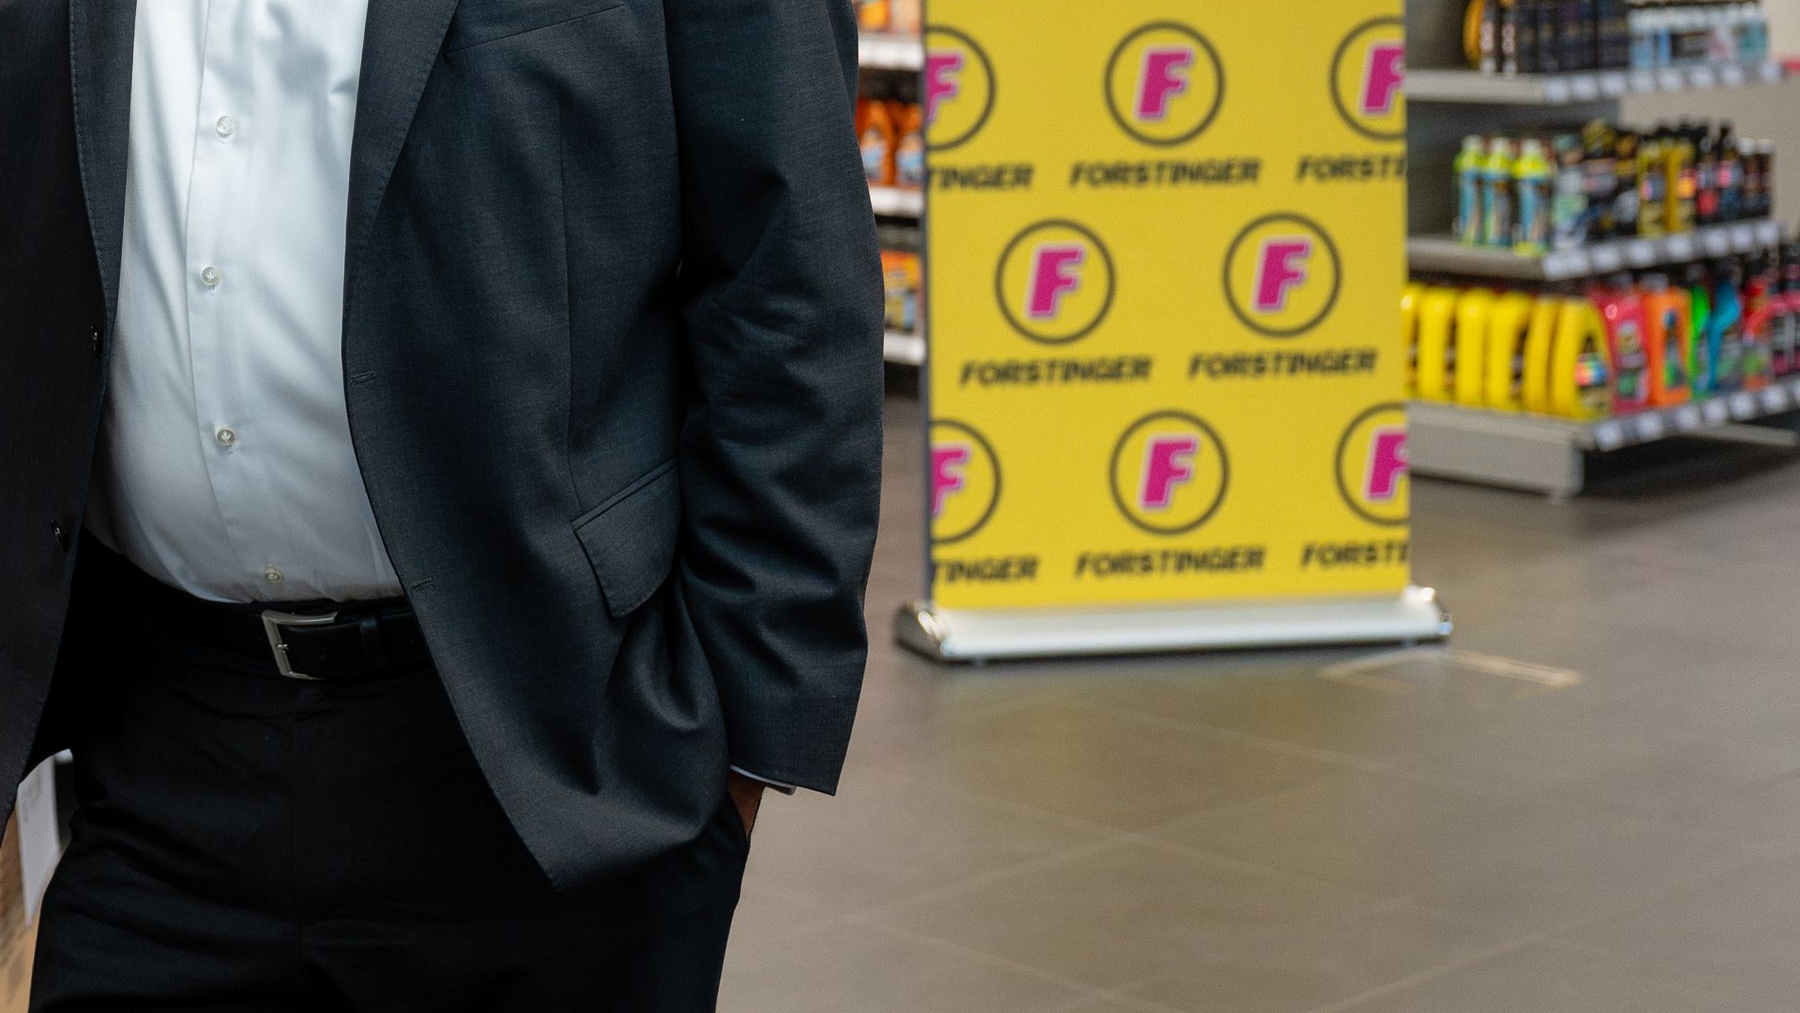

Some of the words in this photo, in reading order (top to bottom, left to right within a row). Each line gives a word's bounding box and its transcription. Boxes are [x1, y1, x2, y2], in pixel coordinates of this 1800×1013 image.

[1134, 44, 1194, 121] F
[1069, 157, 1261, 188] FORSTINGER
[1025, 242, 1086, 320] F
[1252, 236, 1311, 313] F
[959, 354, 1153, 387] FORSTINGER
[1188, 347, 1378, 380] FORSTINGER
[1139, 433, 1199, 510] F
[1075, 544, 1266, 578] FORSTINGER
